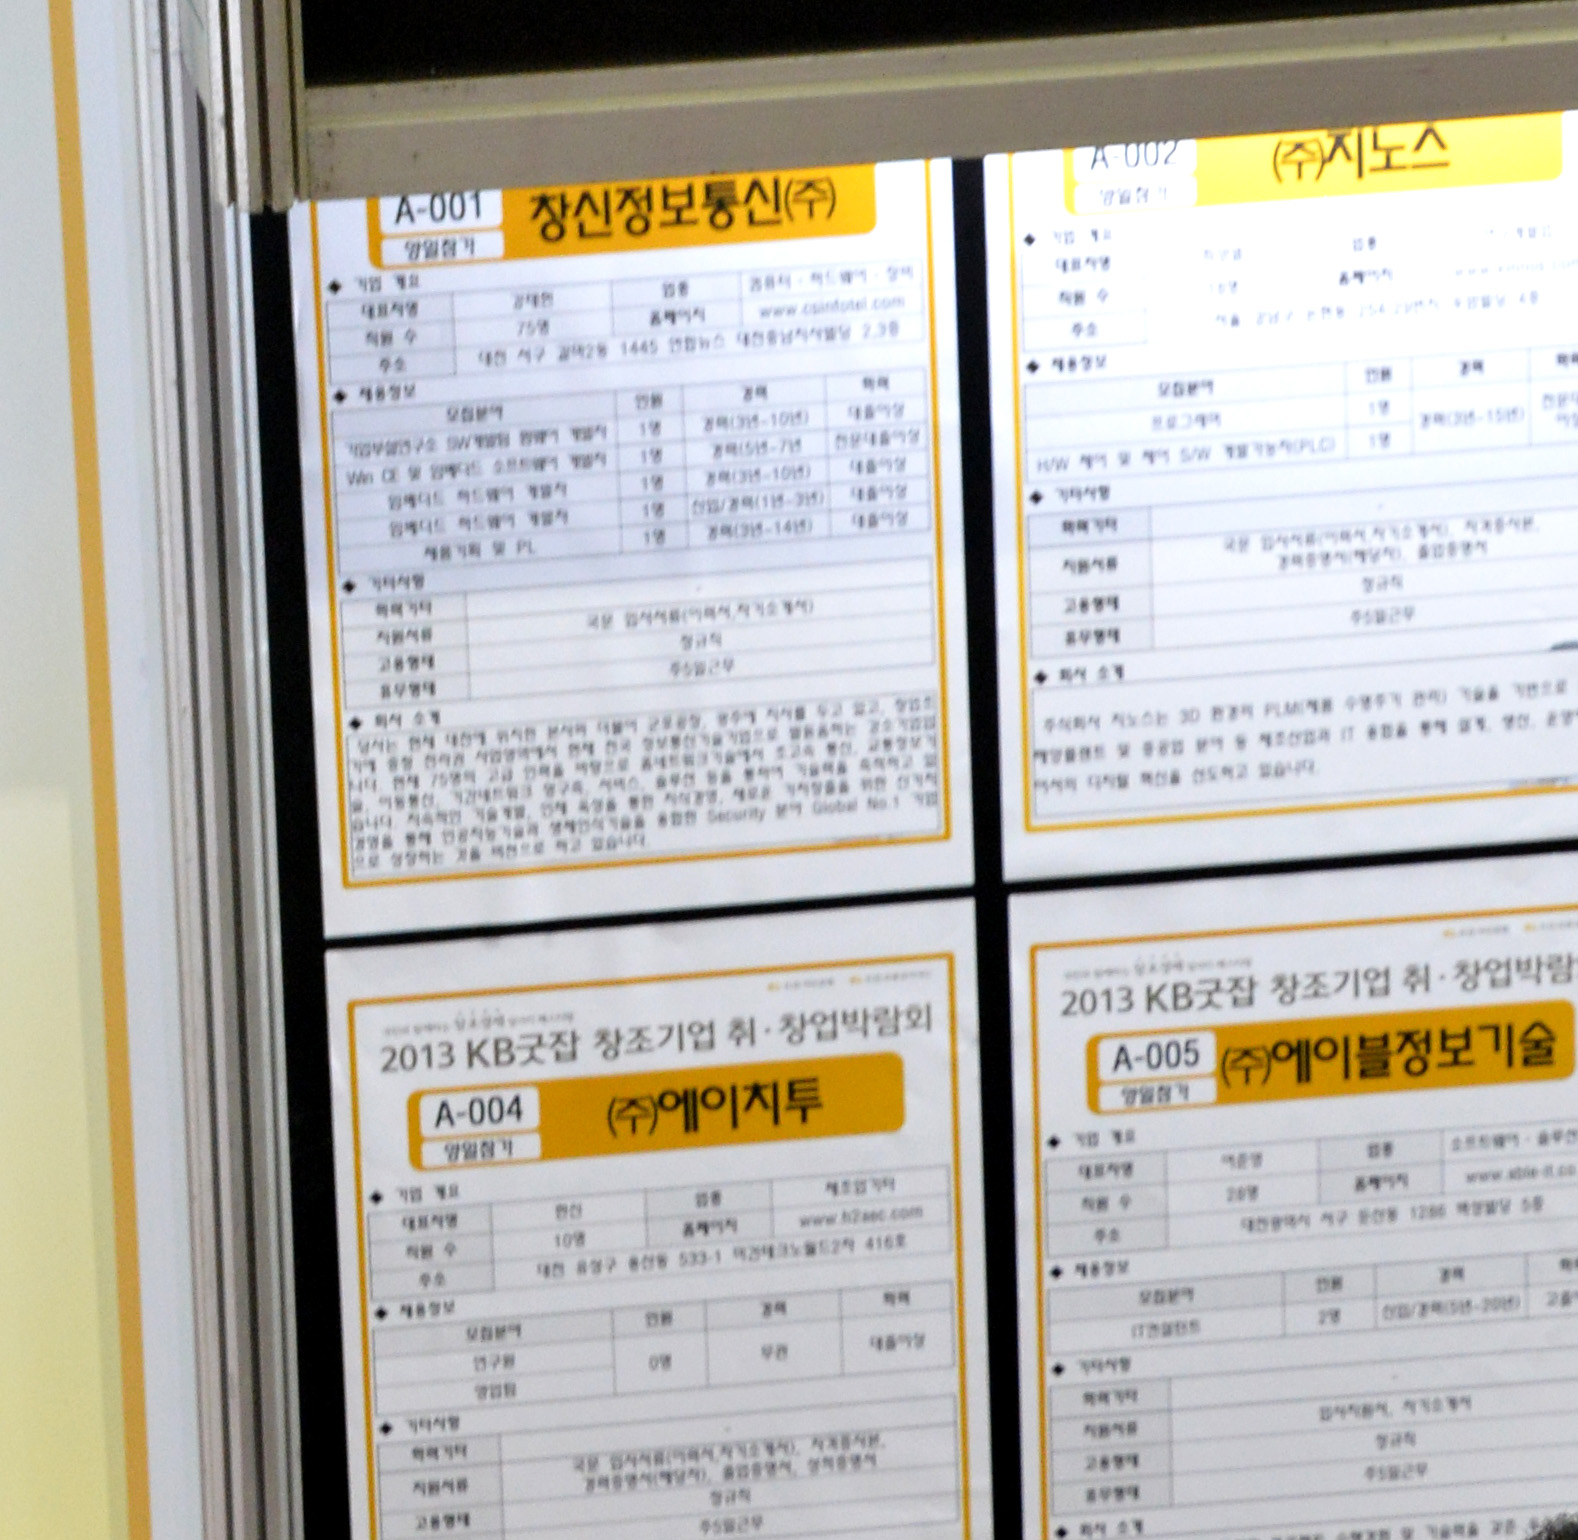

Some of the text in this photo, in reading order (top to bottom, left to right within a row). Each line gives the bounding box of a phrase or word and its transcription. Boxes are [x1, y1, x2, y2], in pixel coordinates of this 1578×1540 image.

[1089, 139, 1178, 170] A-002
[1272, 124, 1451, 183] (주)지노스
[394, 190, 484, 224] A-001
[529, 176, 838, 244] 창신정보통신(주)
[405, 236, 476, 259] 양일참가
[1060, 985, 1134, 1016] 2013
[1144, 978, 1257, 1014] KB굿잡
[1270, 968, 1391, 1004] 창조기업
[380, 1041, 456, 1074] 2013
[466, 1032, 581, 1068] KB굿잡
[593, 1021, 717, 1060] 창조기업
[1112, 1039, 1200, 1071] A-005
[1221, 1019, 1557, 1086] (주)에이블정보기술
[434, 1094, 524, 1128] A-004
[607, 1076, 824, 1136] (주)에이치투
[1121, 1085, 1190, 1107] 양일참가
[444, 1139, 514, 1162] 양일참가
